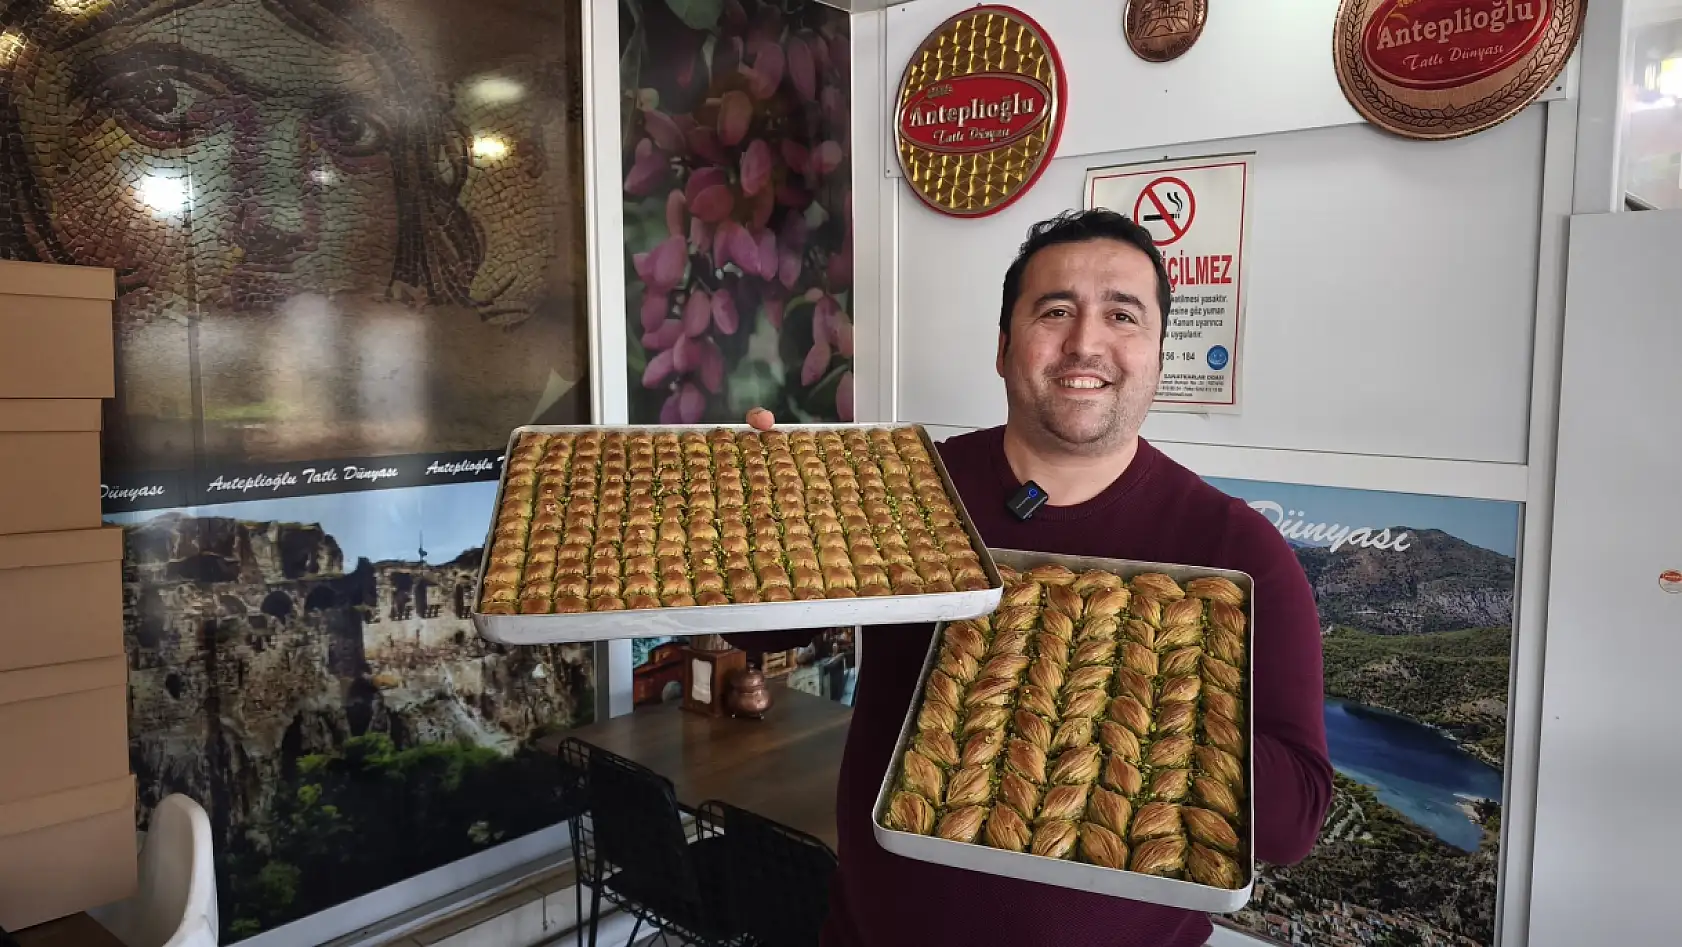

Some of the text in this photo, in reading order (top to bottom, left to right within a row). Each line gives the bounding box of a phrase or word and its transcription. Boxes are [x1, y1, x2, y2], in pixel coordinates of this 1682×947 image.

[1377, 0, 1534, 50] Anteplioğlu
[1403, 44, 1504, 71] Tatlı Dünyası
[909, 92, 1035, 127] Anteplioğlu
[206, 466, 399, 493] Anteplioğlu Tatlı Dünyası
[425, 457, 493, 476] Anteplioğlu
[100, 484, 165, 502] Dünyası
[1247, 500, 1411, 553] Dünyası
